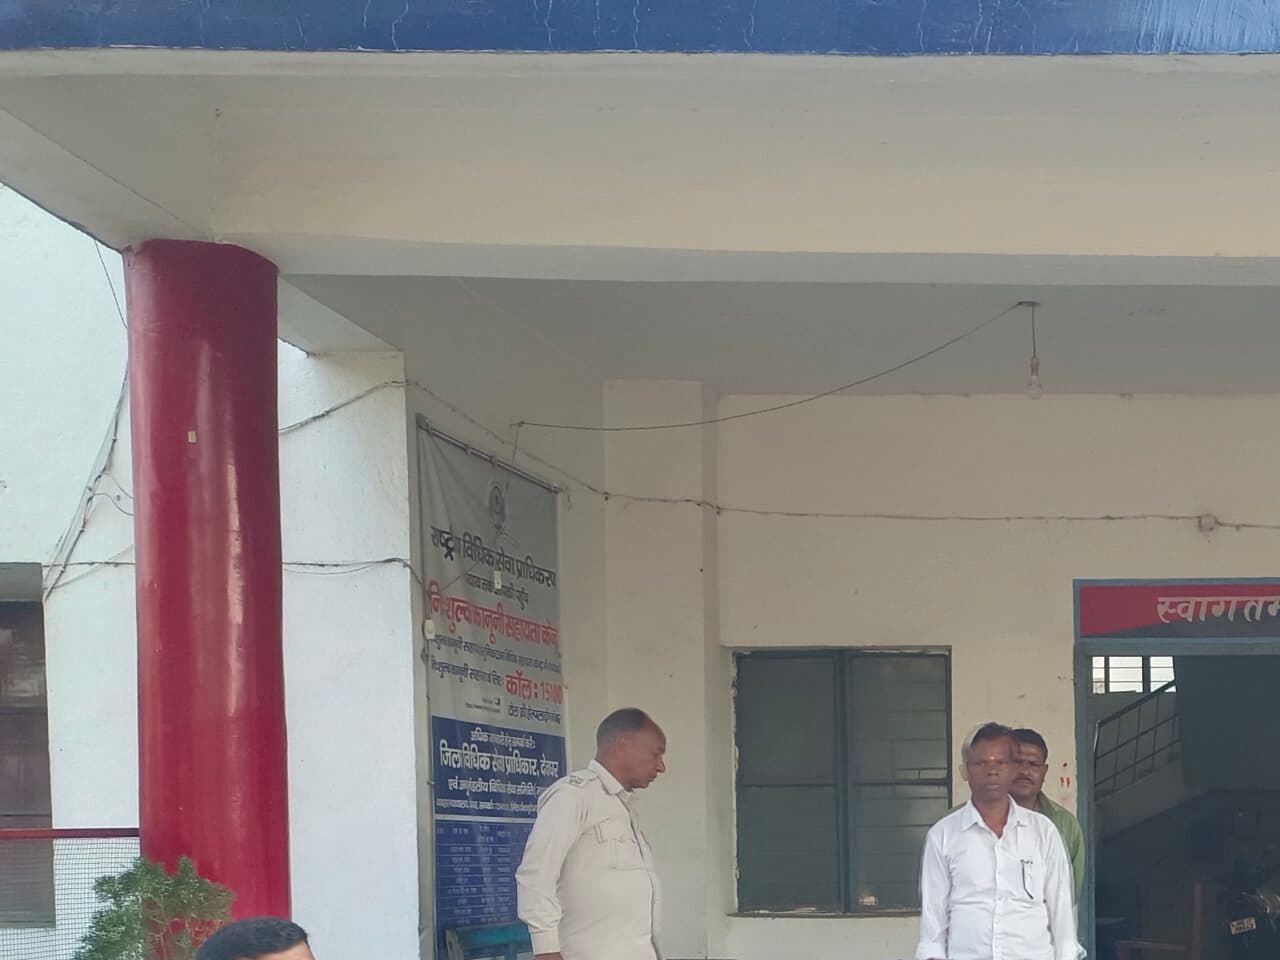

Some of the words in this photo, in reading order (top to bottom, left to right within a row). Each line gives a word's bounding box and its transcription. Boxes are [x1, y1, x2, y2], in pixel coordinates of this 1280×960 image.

[463, 532, 495, 567] विधिक
[505, 667, 532, 699] कॉल
[440, 739, 461, 769] जिला
[462, 742, 491, 770] विधिक
